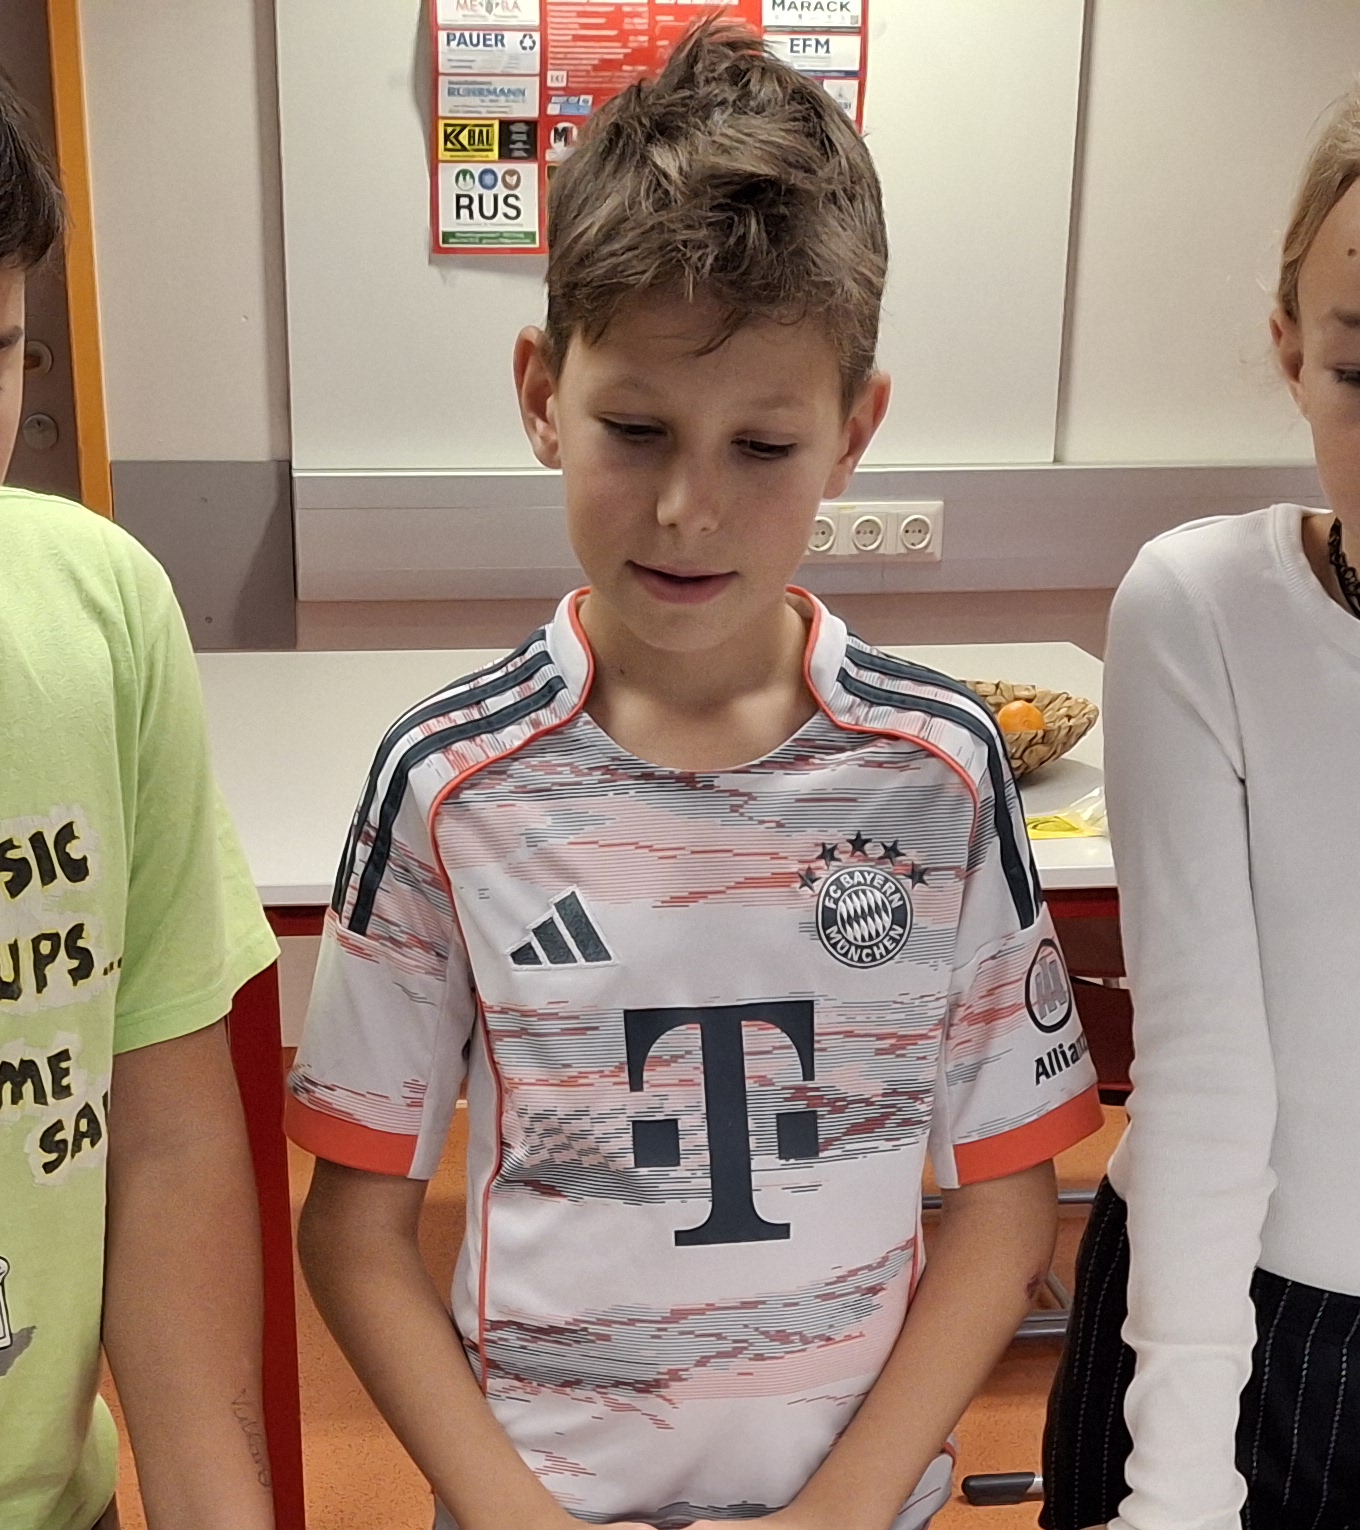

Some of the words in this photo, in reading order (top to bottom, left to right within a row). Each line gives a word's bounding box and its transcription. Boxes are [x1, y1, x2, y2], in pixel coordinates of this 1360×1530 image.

[446, 32, 506, 48] PAUER
[789, 37, 831, 54] EFM
[455, 193, 522, 220] RUS
[824, 885, 842, 909] FC
[840, 871, 904, 909] BAYERN
[40, 1091, 108, 1175] SA
